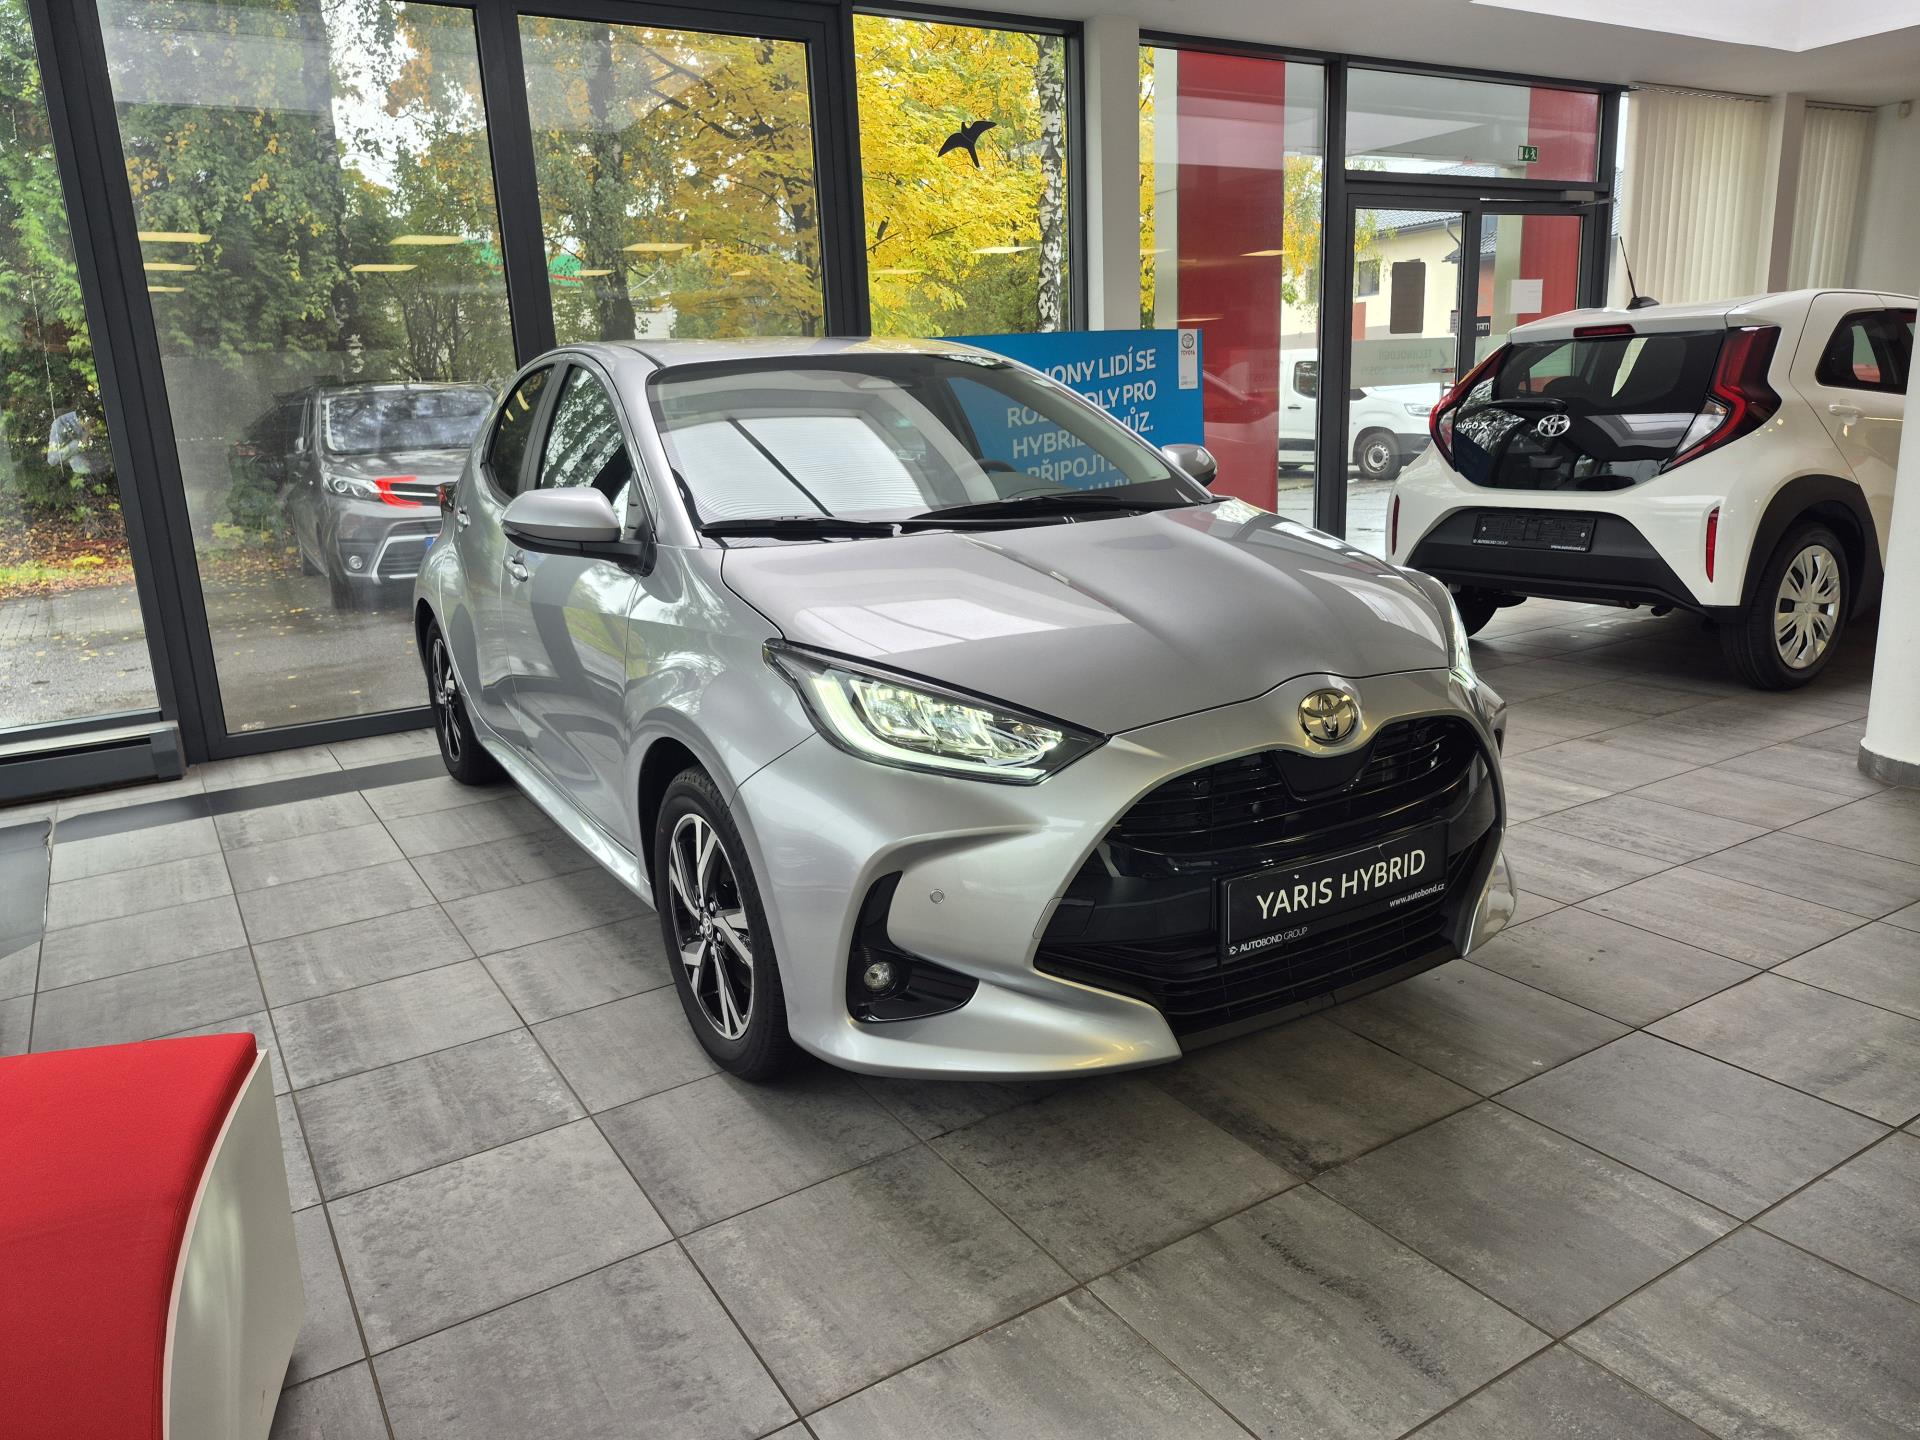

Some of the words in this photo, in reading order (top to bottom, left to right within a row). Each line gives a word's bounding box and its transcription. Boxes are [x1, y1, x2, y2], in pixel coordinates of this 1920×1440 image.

[1099, 346, 1133, 379] LIDÍ
[1136, 348, 1156, 372] SE
[1123, 380, 1156, 406] PRO
[1478, 421, 1490, 434] X
[1256, 877, 1333, 920] YARIS
[1340, 849, 1426, 899] HYBRID
[1389, 882, 1445, 908] www.autobond.cz
[1239, 933, 1283, 953] AUTOBOND
[1283, 926, 1308, 940] GROUP
